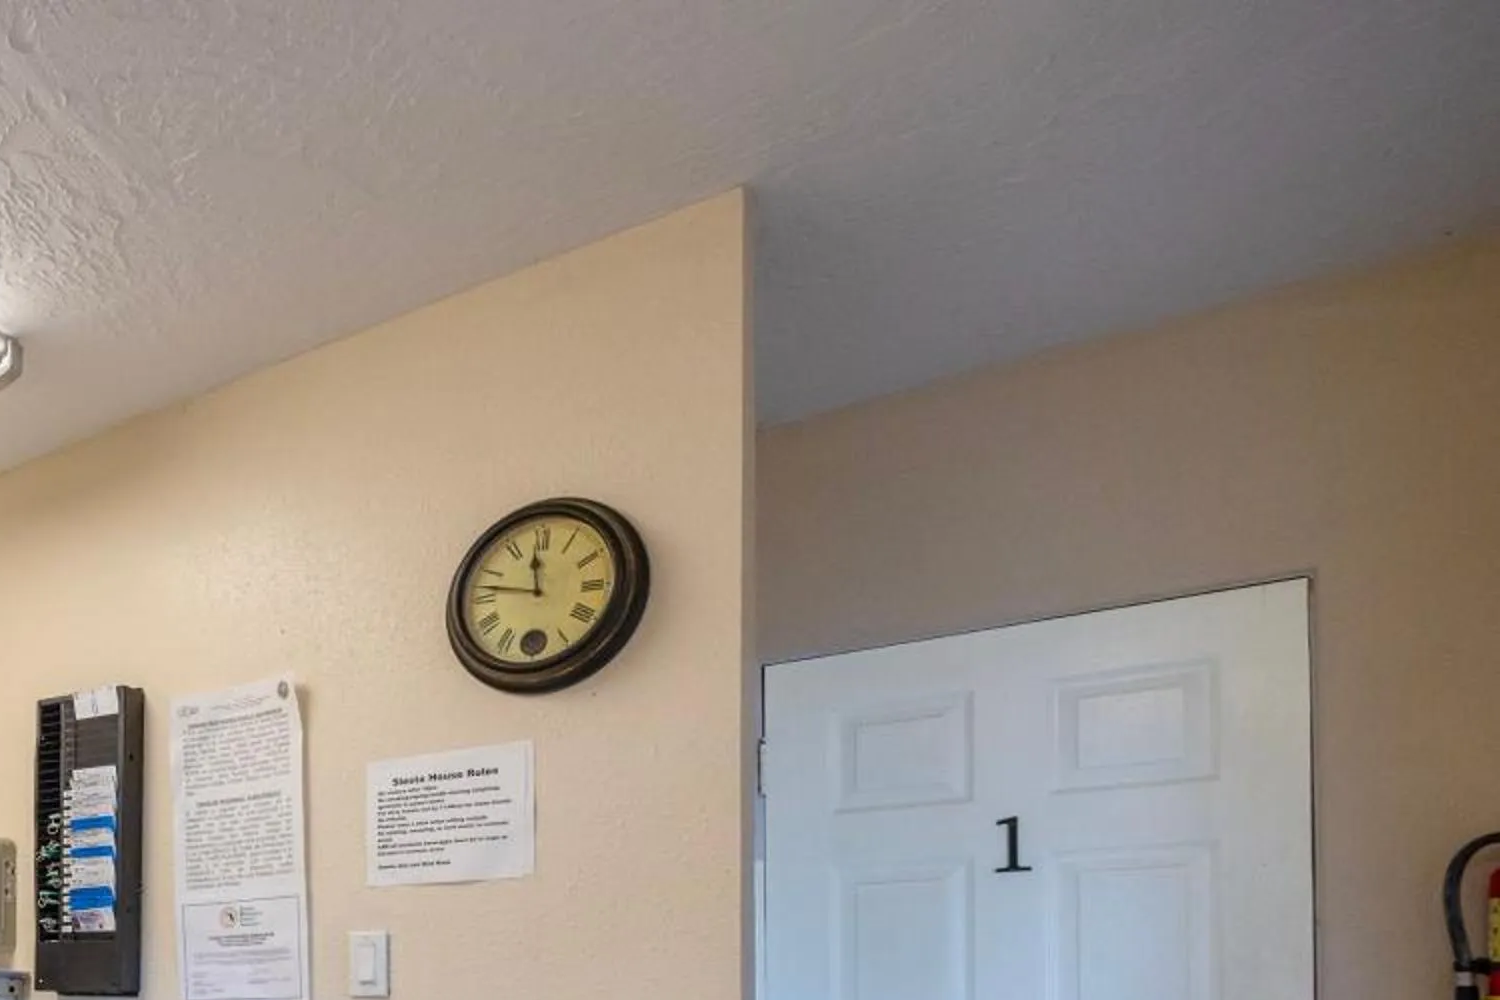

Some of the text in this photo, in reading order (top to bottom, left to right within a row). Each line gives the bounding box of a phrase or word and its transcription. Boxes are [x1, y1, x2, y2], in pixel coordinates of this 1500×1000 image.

[428, 771, 463, 781] House
[467, 767, 499, 778] Rules
[995, 815, 1032, 873] 1
